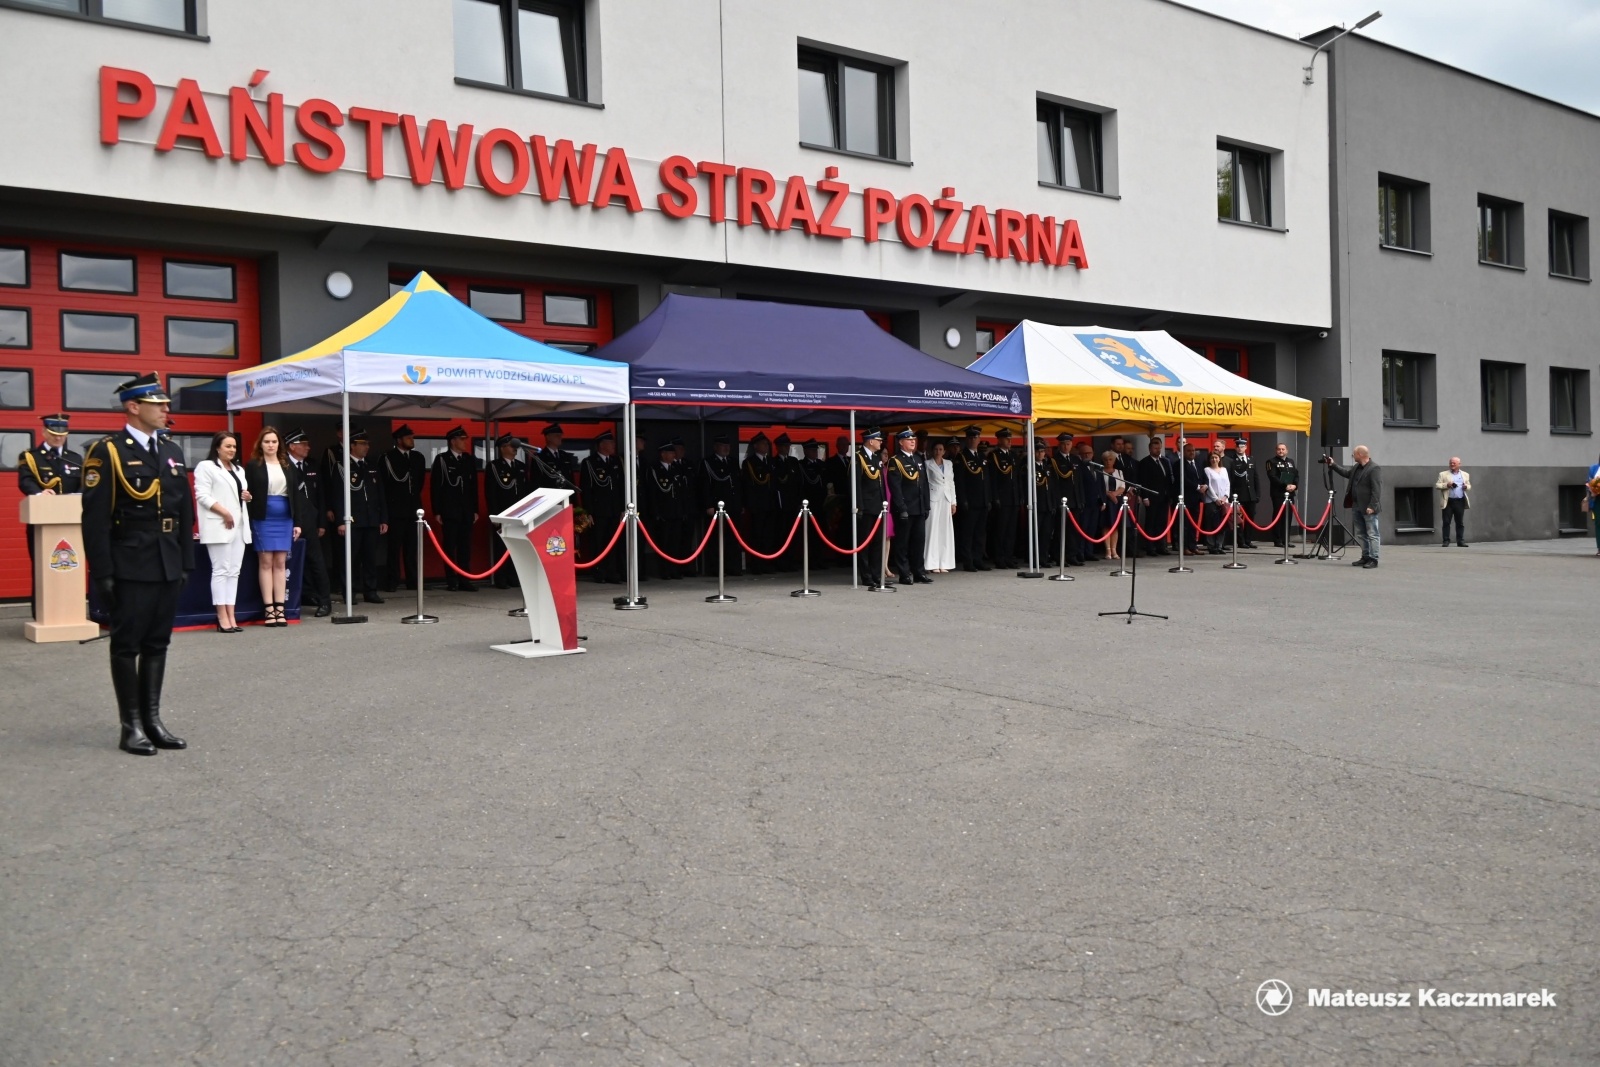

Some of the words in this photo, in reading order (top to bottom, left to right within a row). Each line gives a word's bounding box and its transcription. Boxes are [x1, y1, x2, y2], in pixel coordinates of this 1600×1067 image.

[100, 65, 643, 213] PAŃSTWOWA
[657, 155, 852, 240] STRAŻ
[864, 187, 1089, 270] POŻARNA
[924, 388, 963, 399] PAŃSTWOWA
[963, 391, 982, 400] STRAŻ
[982, 392, 1009, 402] POŻARNA
[1110, 389, 1159, 413] Powiat
[1162, 395, 1253, 417] Wodzisławski
